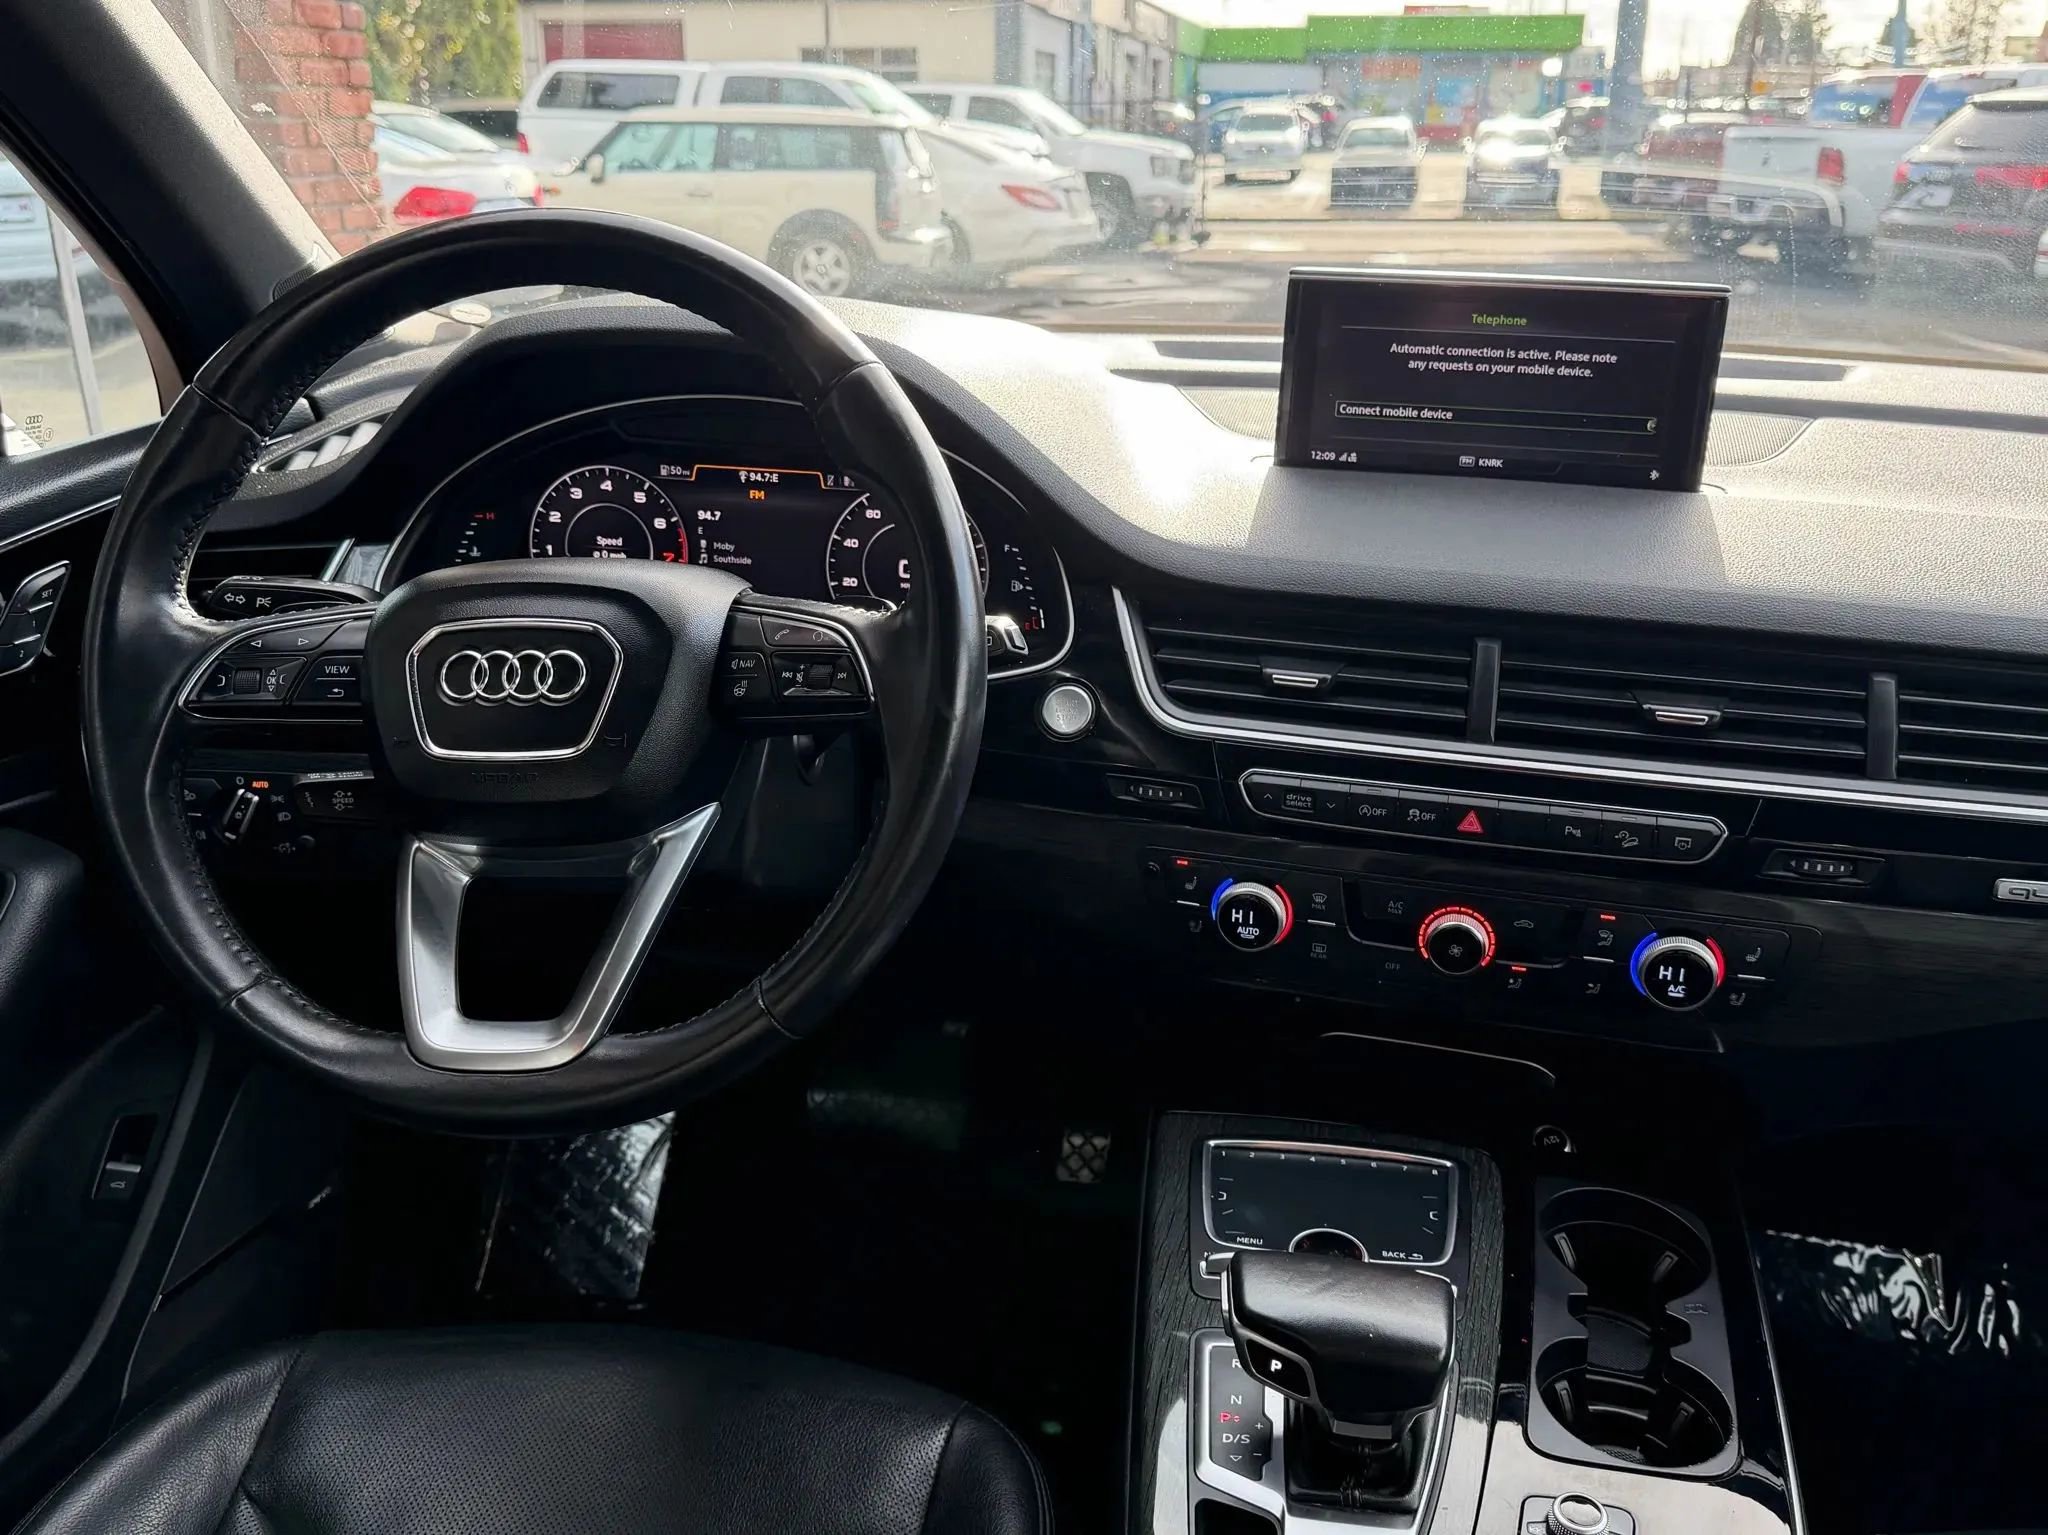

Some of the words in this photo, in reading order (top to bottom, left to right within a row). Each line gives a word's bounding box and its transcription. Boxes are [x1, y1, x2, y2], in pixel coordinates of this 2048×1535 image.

[1472, 313, 1528, 327] Telephone
[1390, 343, 1445, 356] Automatic
[1446, 346, 1504, 359] connection
[1506, 347, 1516, 359] is
[1518, 349, 1552, 361] active.
[1555, 350, 1591, 362] Please
[1592, 353, 1618, 364] note
[1408, 360, 1427, 371] any
[1428, 361, 1474, 373] requests
[1475, 364, 1490, 372] on
[1491, 363, 1516, 375] your
[1517, 364, 1555, 376] mobile
[1556, 366, 1594, 378] device.
[1340, 403, 1381, 416] Connect
[1382, 406, 1418, 418] mobile
[1420, 408, 1453, 420] device
[1311, 450, 1336, 461] 12:09
[1478, 457, 1503, 468] KNRK
[670, 466, 682, 476] 50
[749, 472, 779, 483] 94.7:E
[600, 480, 613, 492] 4
[569, 487, 583, 500] 3
[633, 491, 647, 504] 5
[749, 489, 765, 500] FM
[548, 511, 562, 523] 2
[697, 510, 722, 522] 94.7
[865, 509, 882, 520] 60
[653, 518, 667, 530] 6
[596, 535, 623, 548] Speed
[713, 541, 736, 553] Moby
[843, 538, 860, 549] 40
[546, 544, 552, 556] 1
[1004, 544, 1010, 552] F
[663, 552, 674, 563] 7
[713, 554, 753, 565] Southside
[842, 577, 859, 588] 20
[739, 659, 756, 669] NAV
[324, 665, 351, 675] VIEW
[266, 676, 278, 686] OK
[252, 780, 269, 789] AUTO
[1286, 794, 1312, 802] drive
[1286, 800, 1312, 809] select
[1372, 808, 1388, 817] OFF
[1421, 811, 1436, 823] OFF
[1312, 902, 1326, 911] MAX
[1388, 899, 1404, 909] A/C
[1237, 926, 1260, 937] AUTO
[1385, 961, 1401, 971] OFF
[1667, 984, 1687, 994] A/C
[1221, 1150, 1226, 1158] 1
[1432, 1168, 1438, 1176] 8
[1236, 1236, 1263, 1246] MENU
[1382, 1250, 1406, 1260] BACK
[1232, 1358, 1242, 1369] R
[1270, 1359, 1282, 1372] P
[1231, 1395, 1242, 1405] N
[1220, 1412, 1231, 1424] P
[1222, 1433, 1251, 1445] D/S
